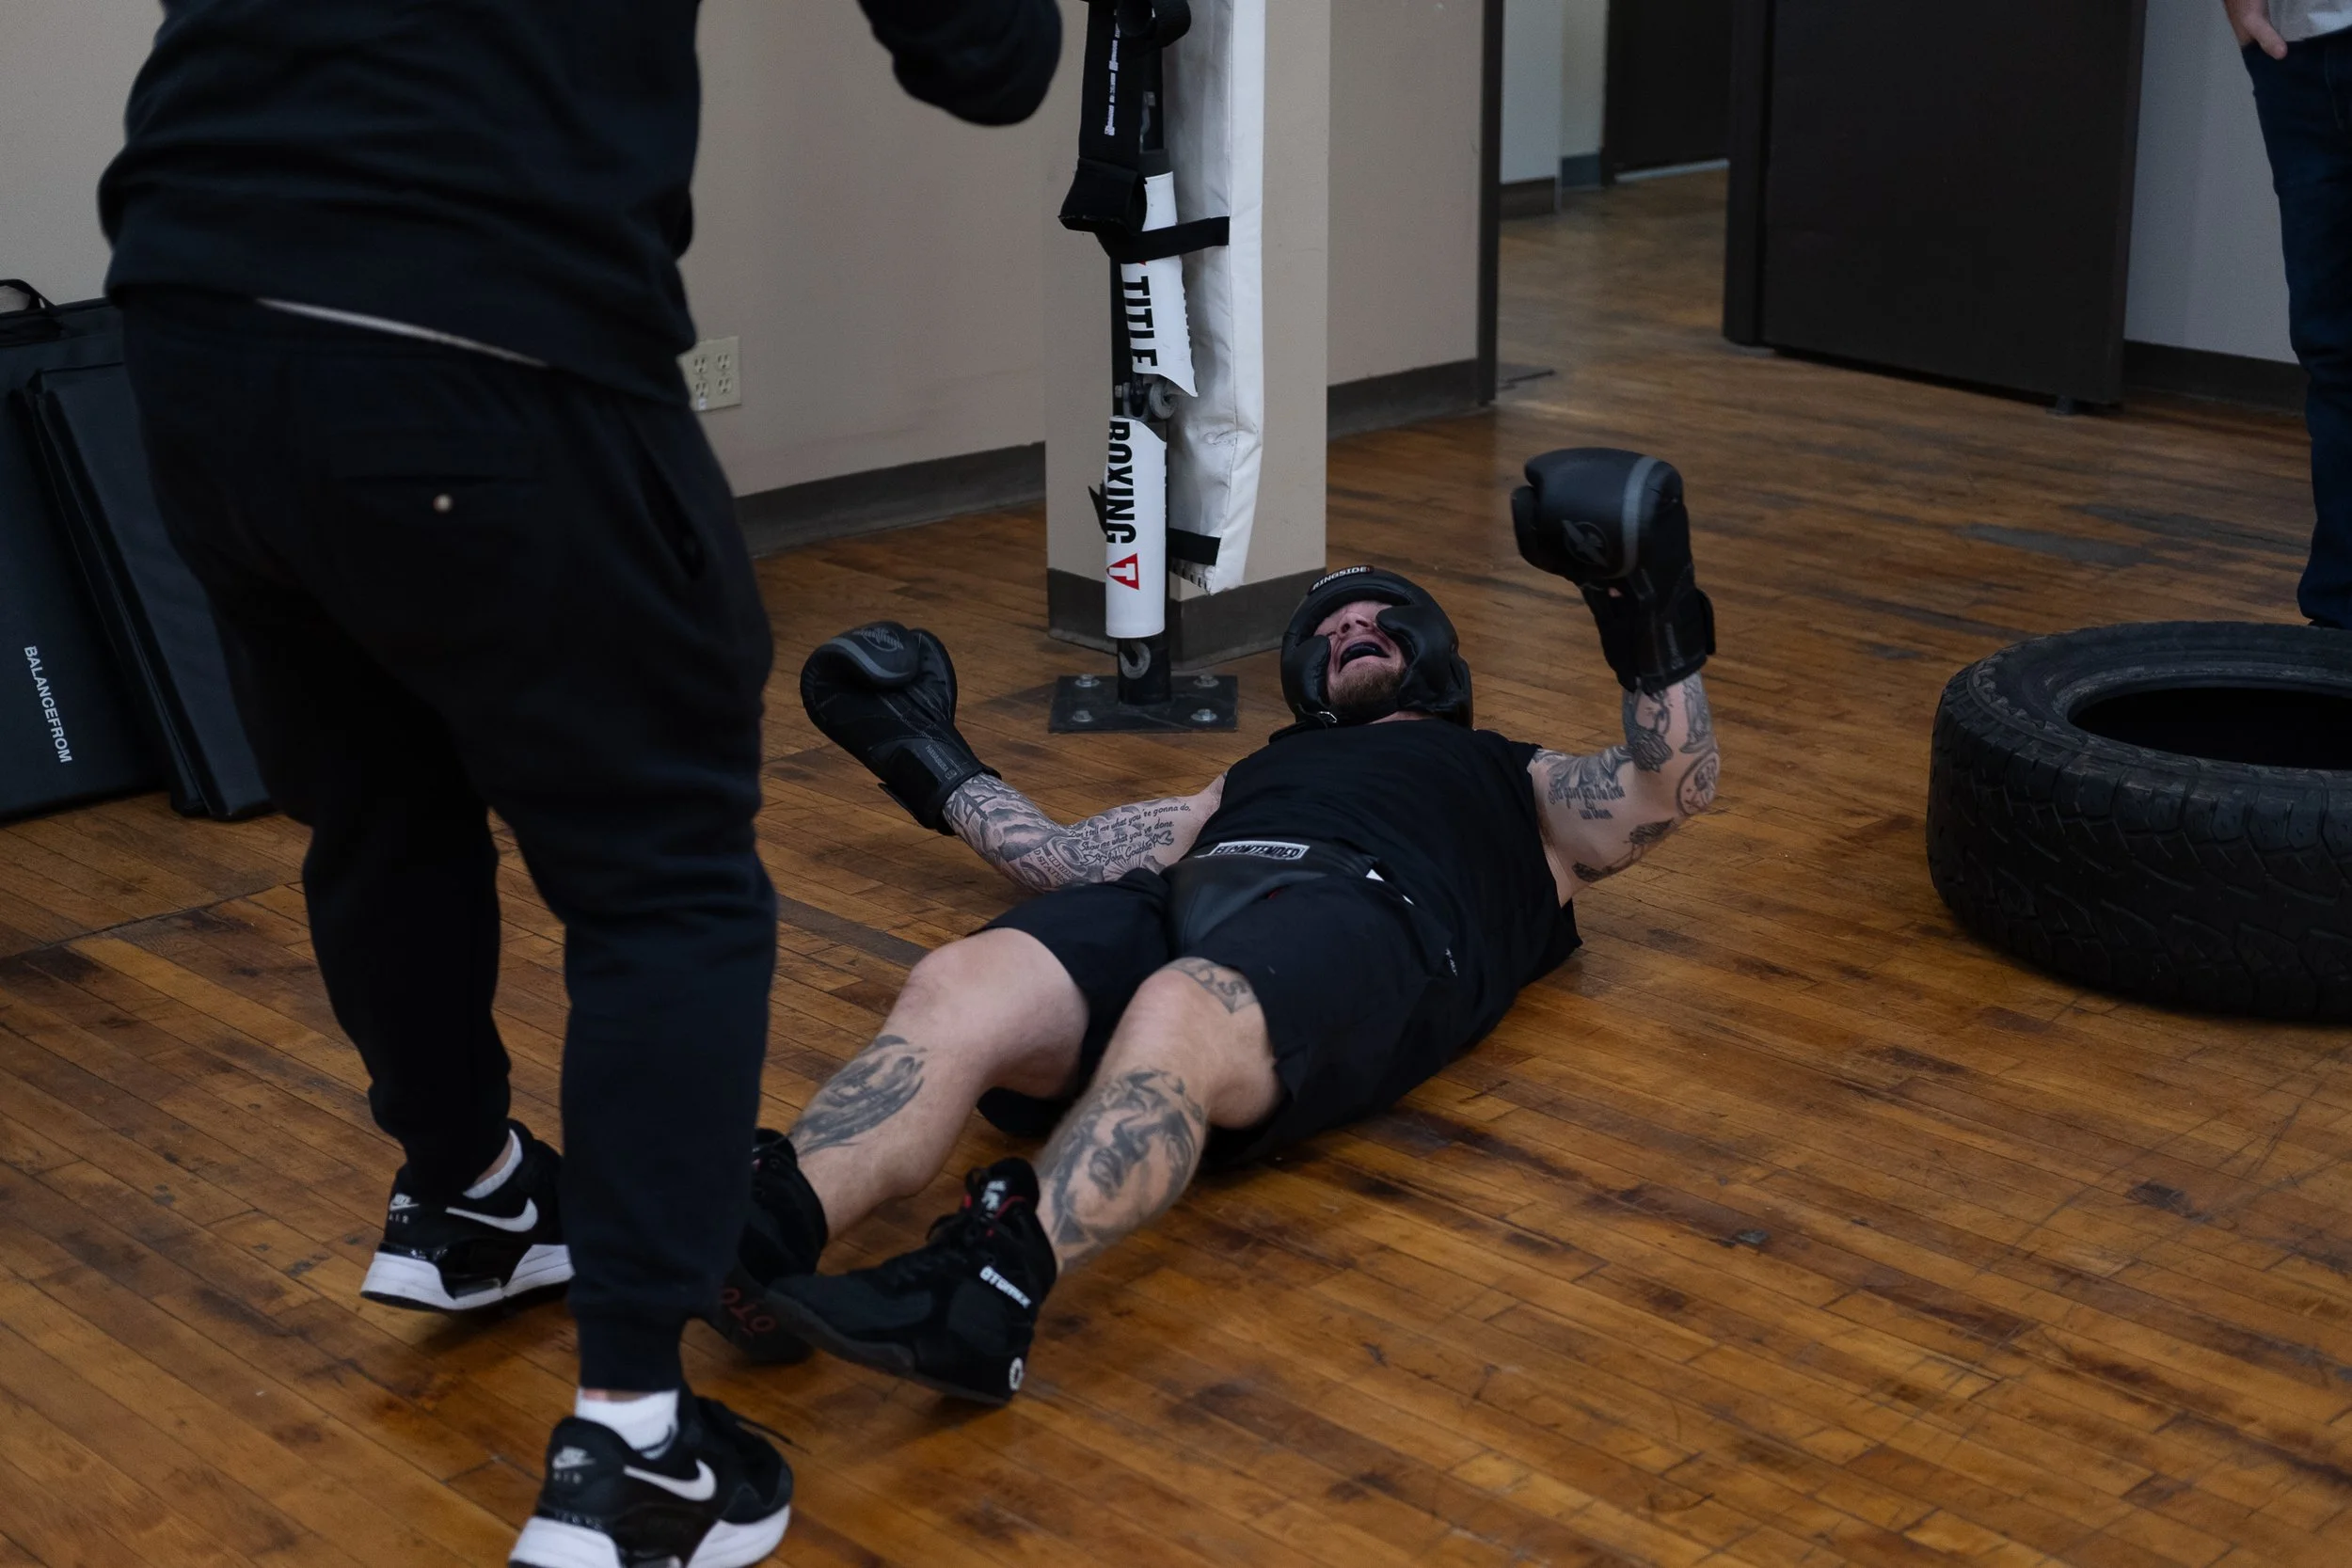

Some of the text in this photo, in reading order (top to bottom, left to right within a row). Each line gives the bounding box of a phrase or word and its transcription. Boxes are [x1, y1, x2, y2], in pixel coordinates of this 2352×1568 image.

[1106, 421, 1136, 544] BOXING
[1311, 566, 1368, 591] RINGSIDE
[24, 645, 72, 763] BALANCEFROM
[1111, 818, 1127, 832] what
[1153, 806, 1179, 816] gonna
[1111, 833, 1128, 846] what
